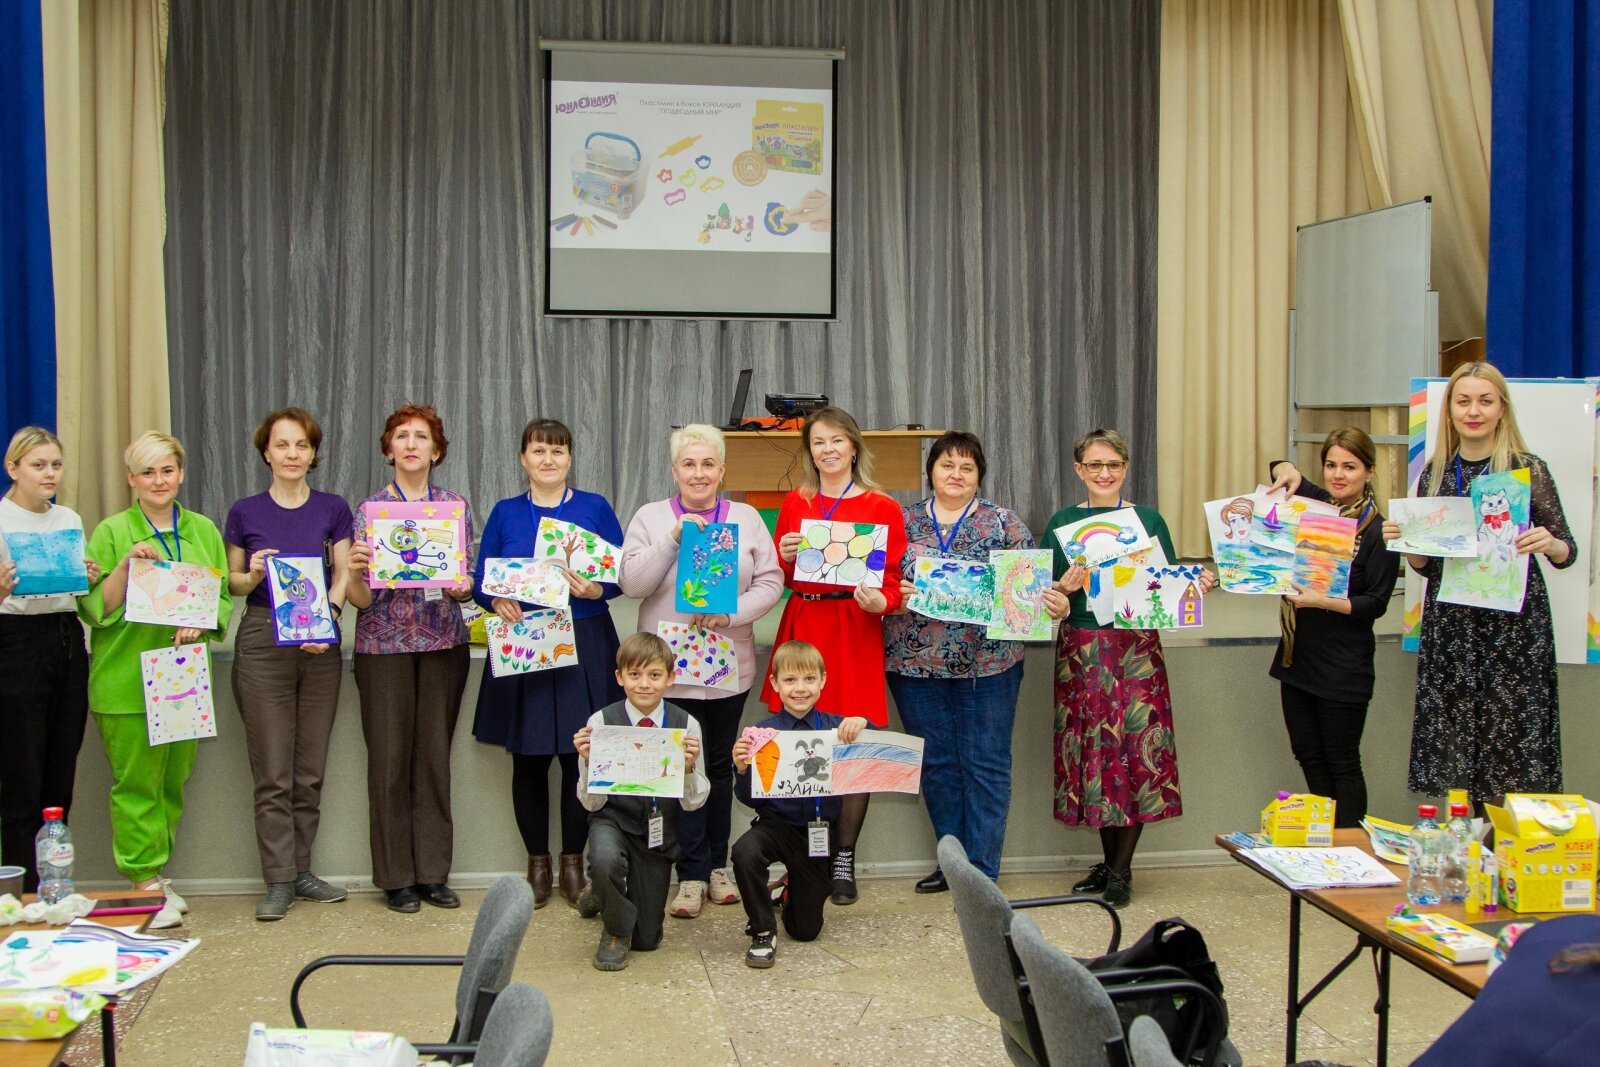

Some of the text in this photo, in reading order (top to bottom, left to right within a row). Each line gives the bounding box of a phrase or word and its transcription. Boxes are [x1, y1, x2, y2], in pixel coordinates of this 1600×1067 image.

[639, 99, 675, 107] Пластилин
[702, 101, 742, 109] ЮНЛАНДИЯ
[1565, 840, 1593, 851] КЛЕЙ
